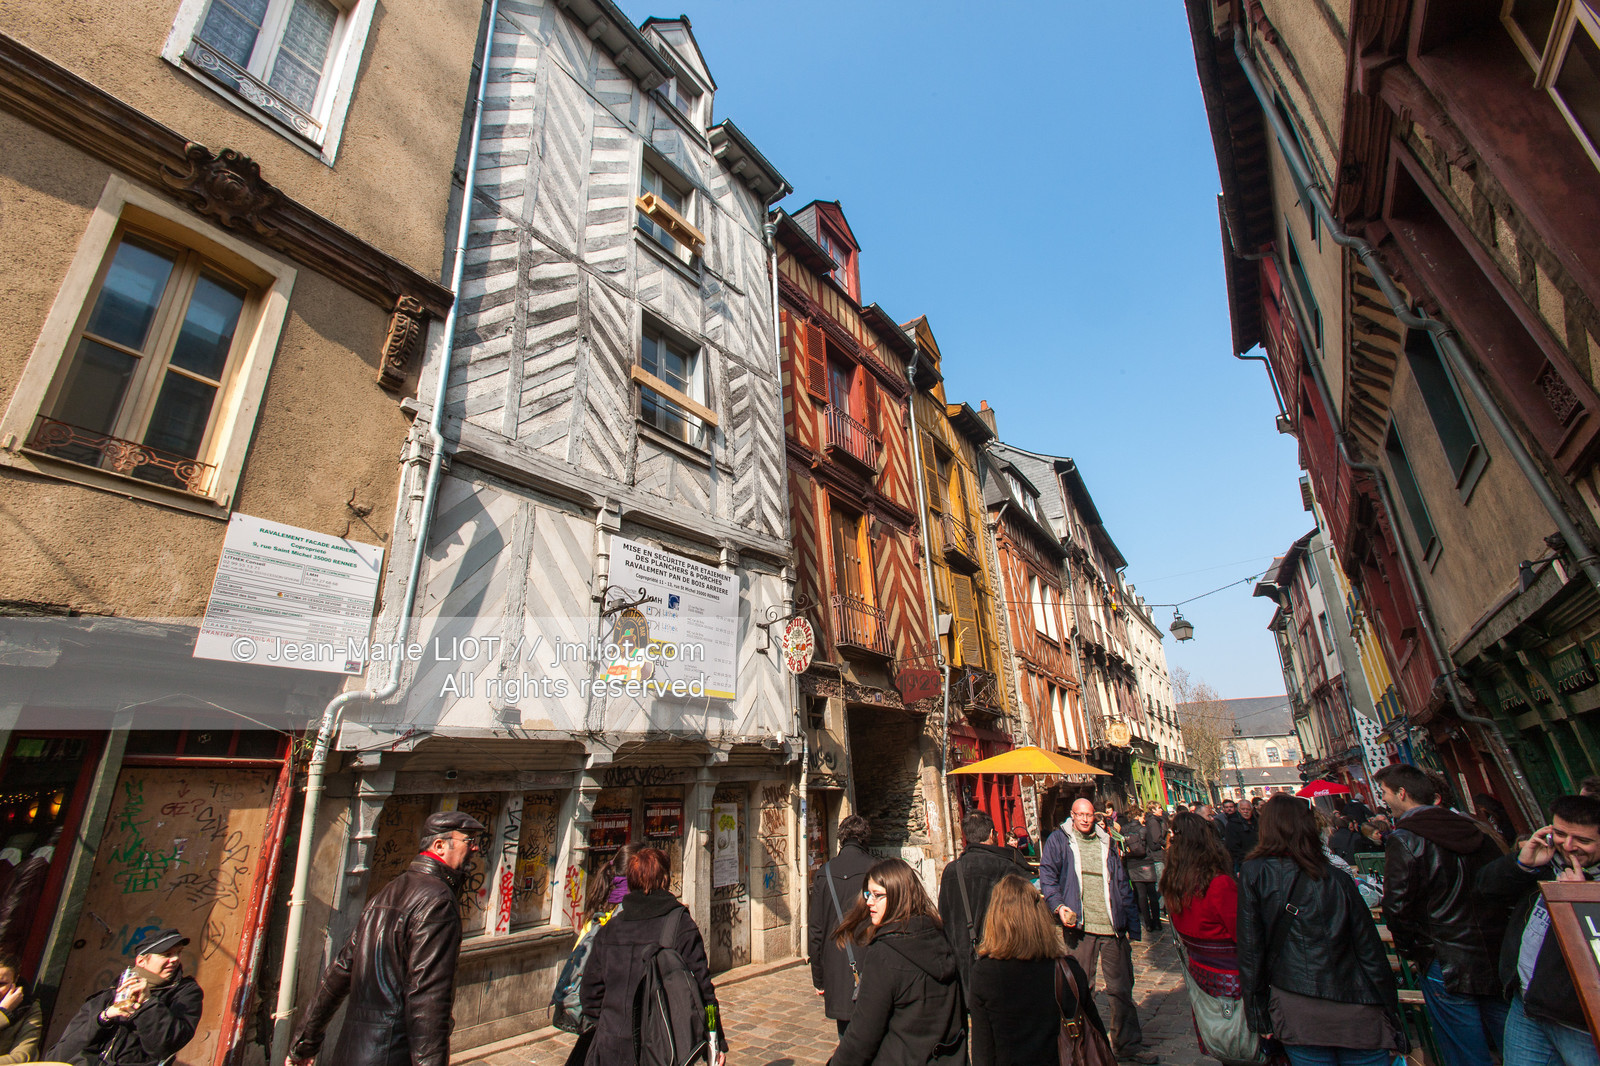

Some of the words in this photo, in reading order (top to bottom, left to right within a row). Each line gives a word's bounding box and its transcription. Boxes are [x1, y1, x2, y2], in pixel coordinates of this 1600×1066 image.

[258, 527, 304, 542] RAVALEMENT
[305, 538, 330, 548] FACADE
[330, 544, 357, 554] ARRIERE
[273, 545, 290, 553] Saint
[291, 549, 312, 558] Michel
[313, 554, 331, 562] 35000
[332, 558, 357, 568] RENNES
[623, 542, 641, 554] MISE
[643, 549, 652, 557] EN
[654, 552, 685, 568] SECURITE
[686, 562, 698, 572] PAR
[700, 567, 730, 582] ETAIEMENT
[635, 553, 649, 563] DES
[650, 558, 688, 575] PLANCHERS
[696, 572, 721, 586] PORCHES
[625, 559, 667, 577] RAVALEMENT
[668, 572, 680, 581] PAN
[682, 576, 690, 584] DE
[691, 579, 704, 589] BOIS
[706, 583, 728, 596] ARRIERE
[200, 629, 235, 638] CHANTIER
